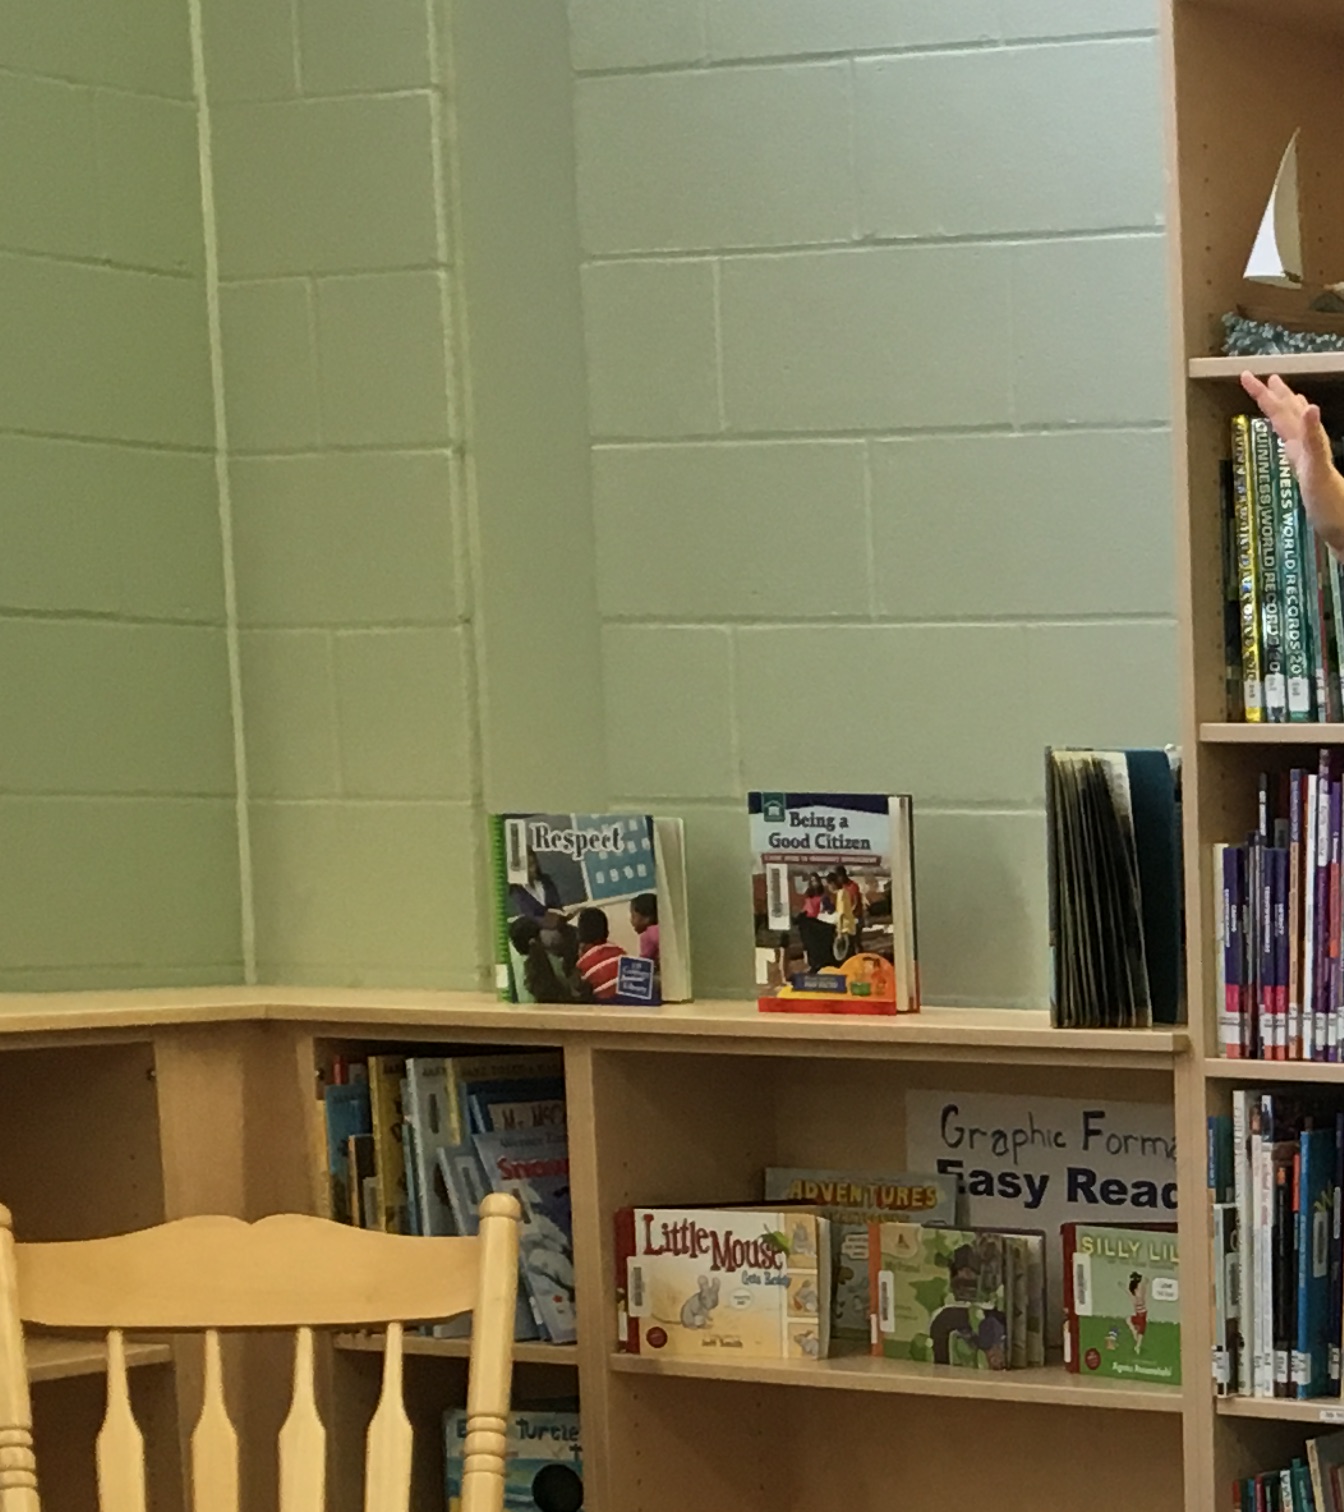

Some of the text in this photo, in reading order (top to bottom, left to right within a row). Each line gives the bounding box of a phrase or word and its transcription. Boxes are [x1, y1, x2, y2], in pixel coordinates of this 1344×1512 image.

[1254, 420, 1280, 646] GUINNESS WORLD RECORDS
[1276, 438, 1301, 650] UINNESS WORLD RECORDS
[529, 822, 626, 859] Respect
[768, 832, 872, 850] Good Citizen
[789, 811, 849, 832] Being a
[940, 1104, 1068, 1166] Graphic
[787, 1179, 941, 1210] ADVENTURES
[936, 1158, 1051, 1210] Easy
[642, 1213, 711, 1261] Little
[710, 1231, 785, 1274] Mouse
[1080, 1235, 1141, 1259] SILLY
[515, 1417, 580, 1442] Turtle
